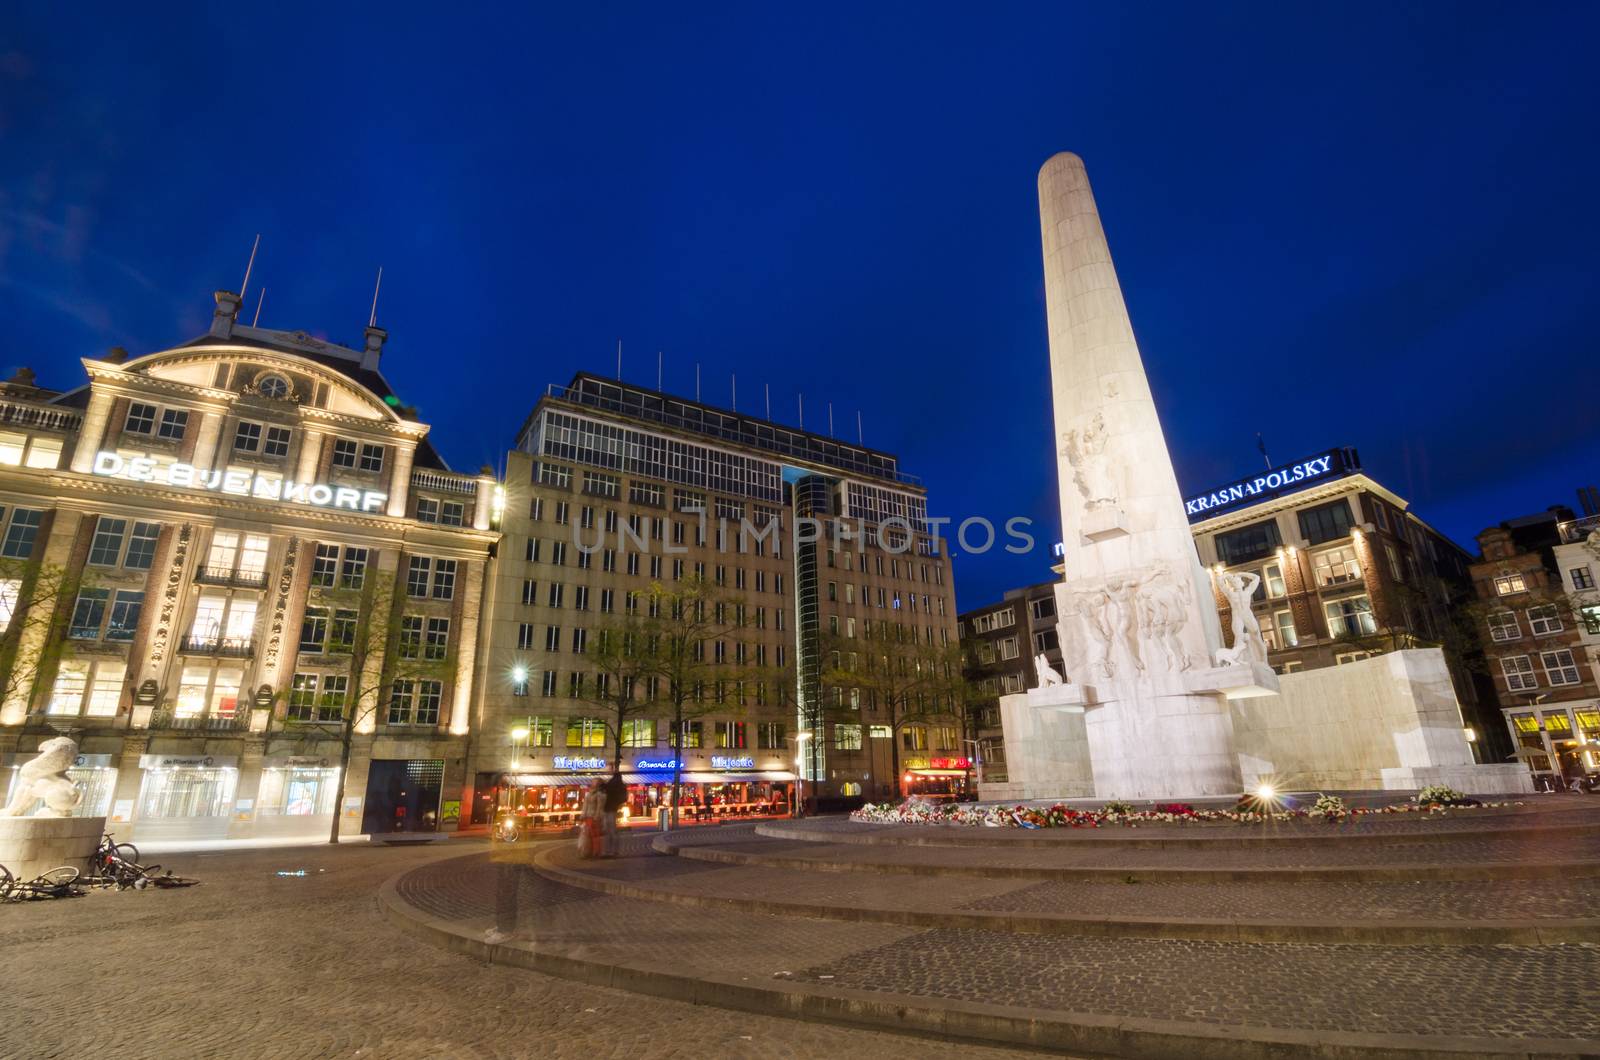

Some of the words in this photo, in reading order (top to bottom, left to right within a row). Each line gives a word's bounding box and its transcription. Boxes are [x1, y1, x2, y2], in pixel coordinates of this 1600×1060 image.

[92, 450, 157, 482] DE
[1186, 455, 1331, 515] KRASNAPOLSKY
[553, 756, 606, 771] Majestic
[711, 756, 753, 770] Majestic
